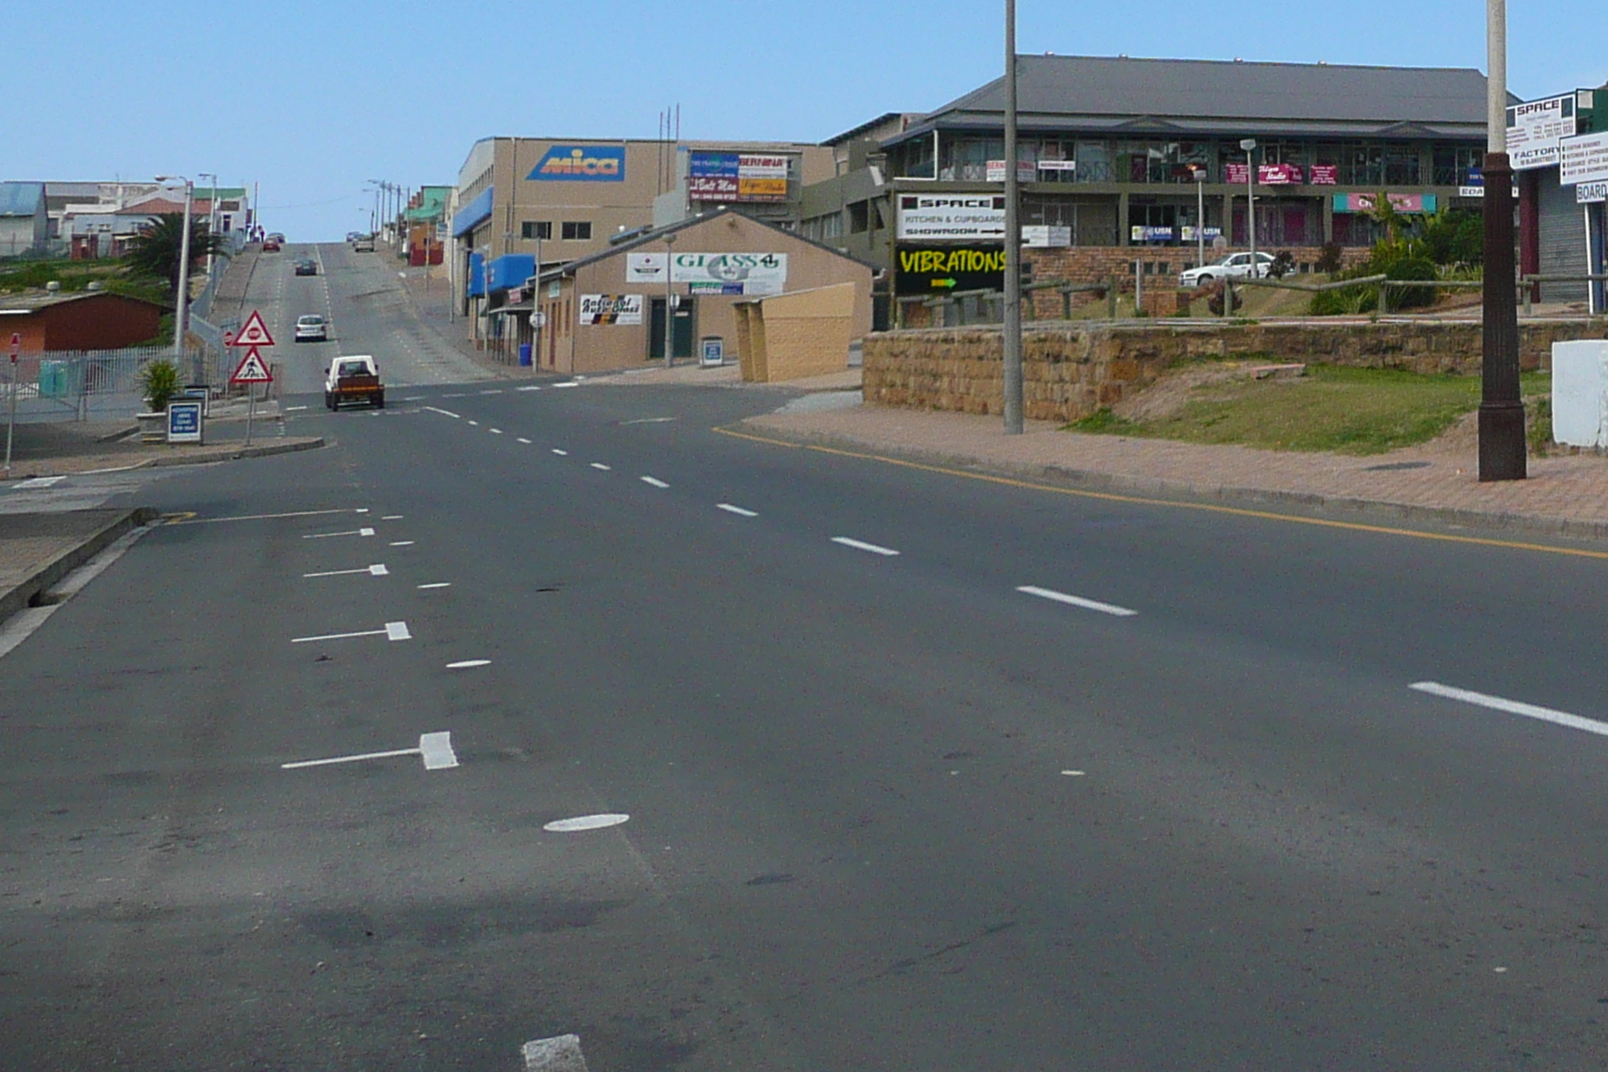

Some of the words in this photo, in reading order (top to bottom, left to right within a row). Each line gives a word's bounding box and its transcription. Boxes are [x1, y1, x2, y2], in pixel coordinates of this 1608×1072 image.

[1517, 99, 1560, 116] SPACE
[1514, 146, 1560, 160] FACTORY
[1577, 182, 1607, 201] BOARD
[919, 199, 991, 208] SPACE
[905, 215, 944, 224] KITCHEN
[946, 215, 952, 224] &
[675, 254, 759, 269] GLASS
